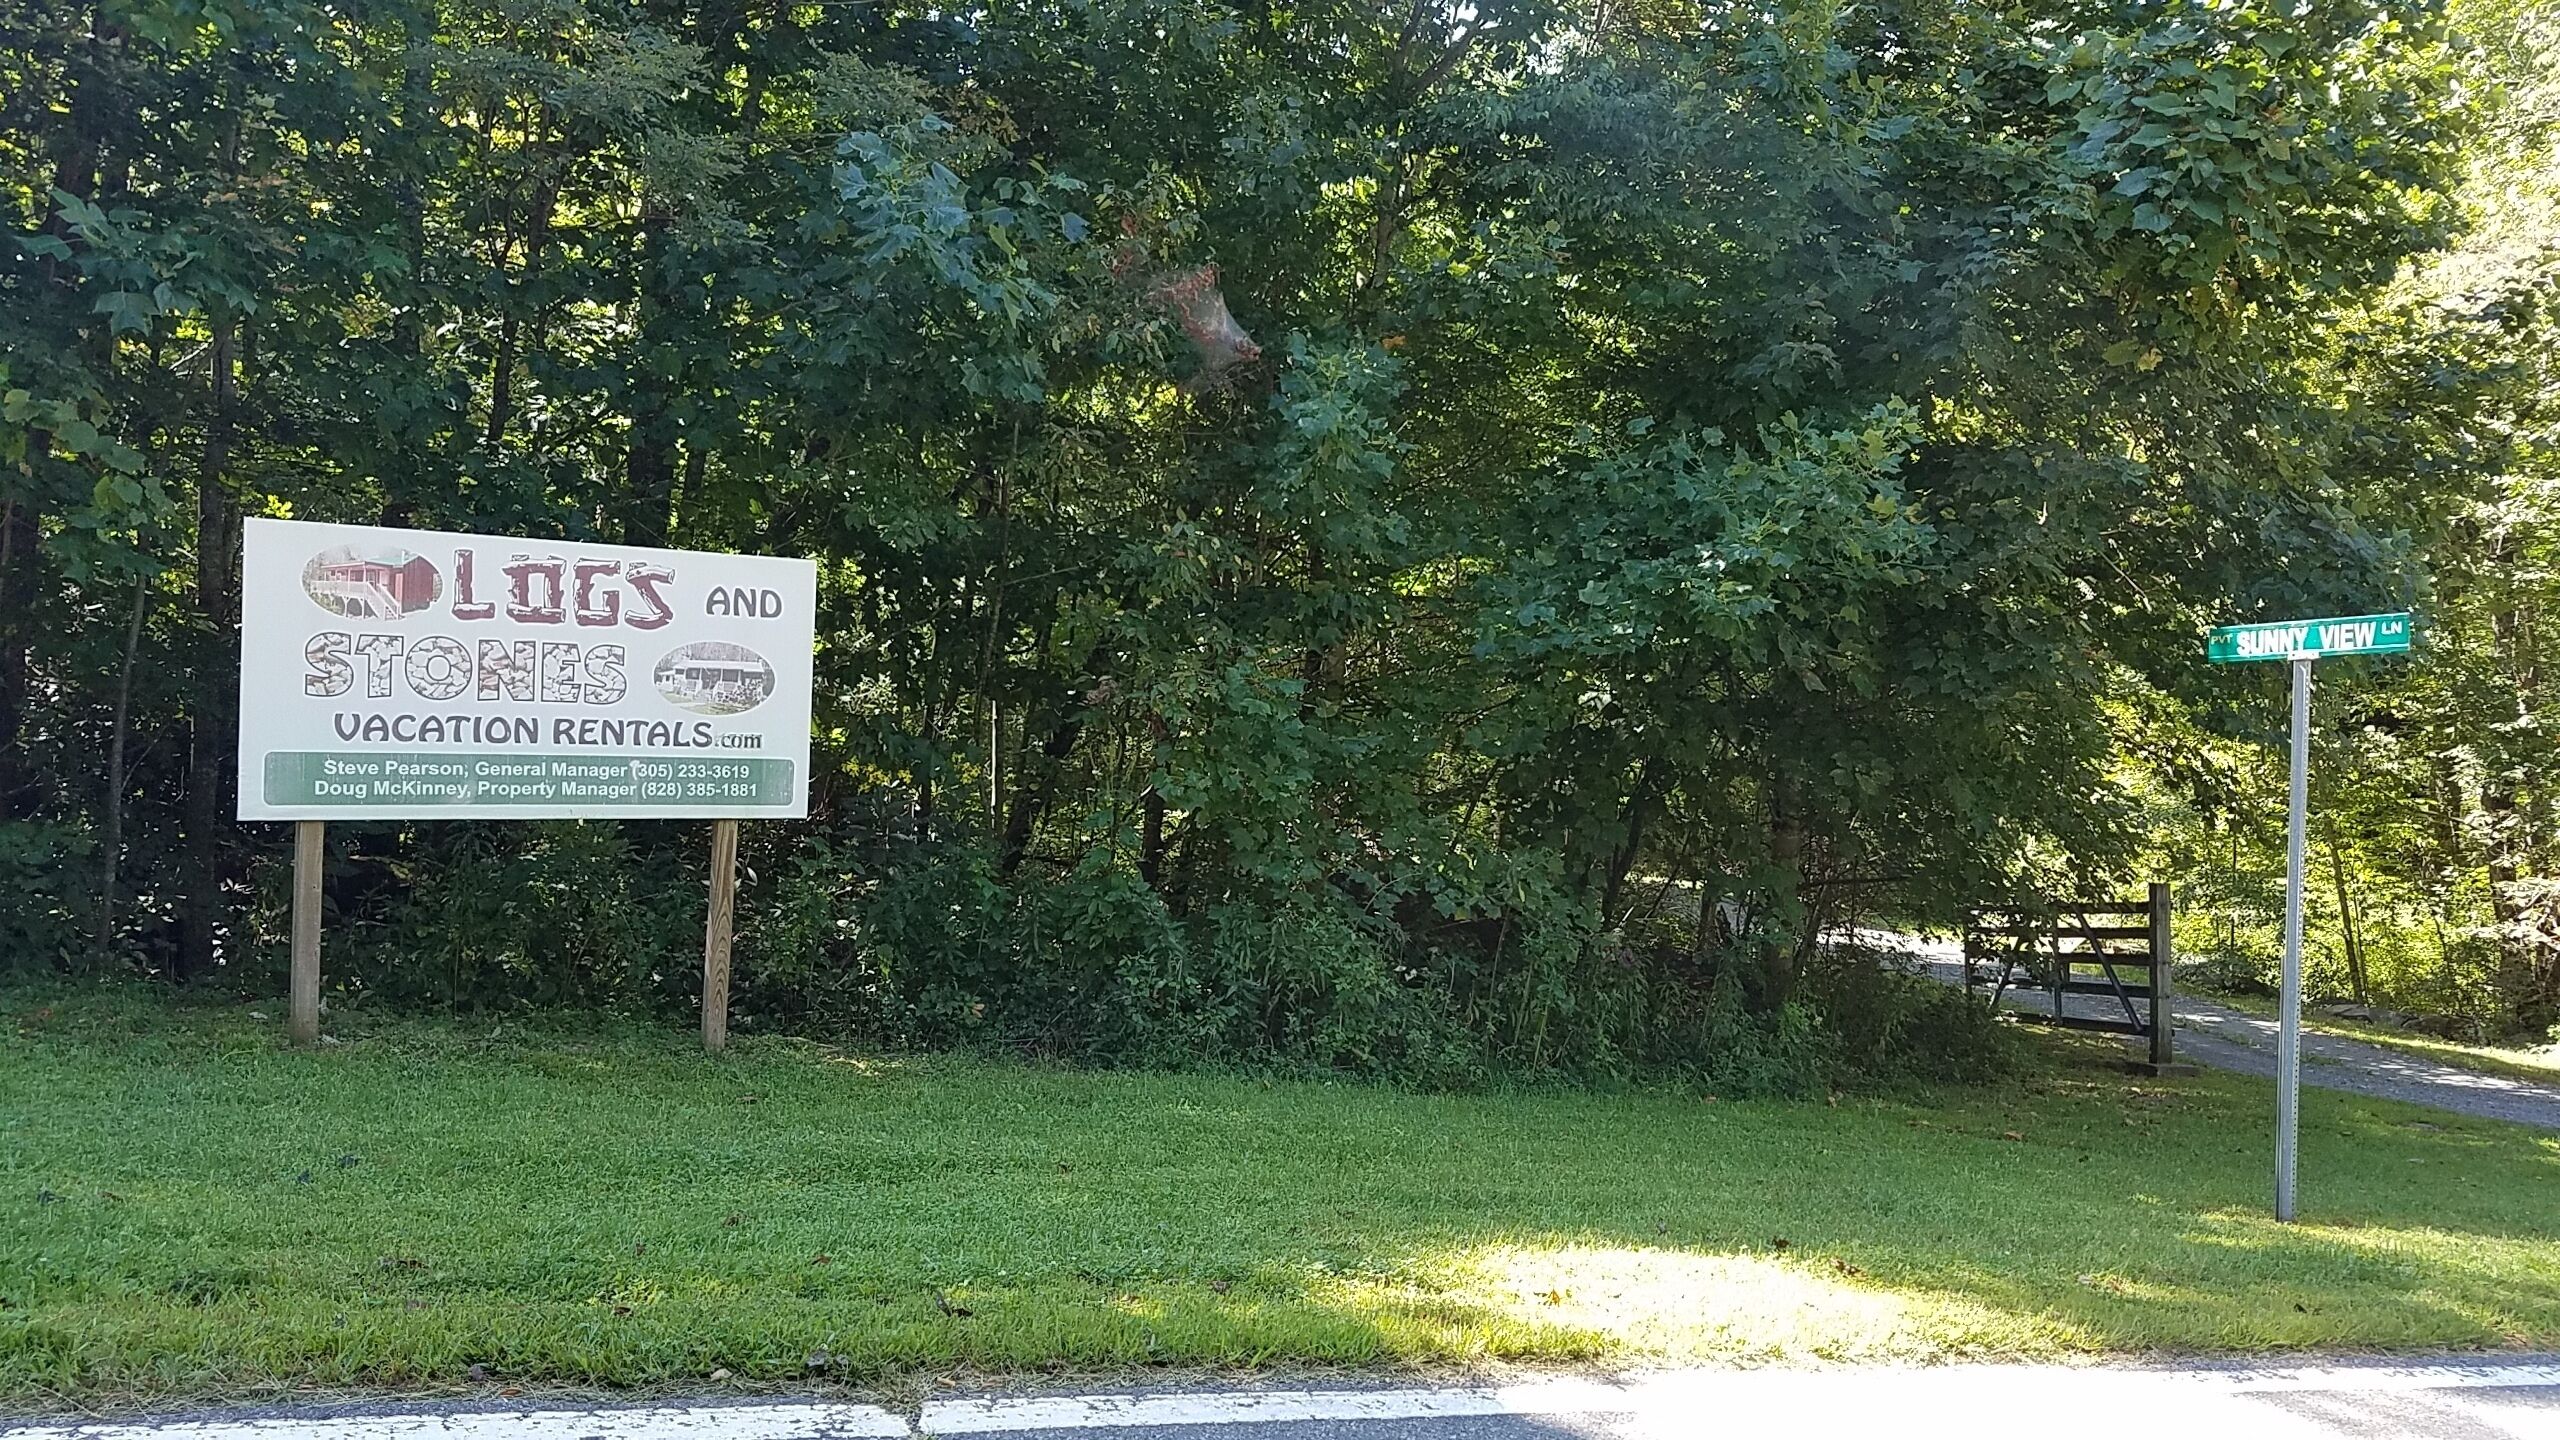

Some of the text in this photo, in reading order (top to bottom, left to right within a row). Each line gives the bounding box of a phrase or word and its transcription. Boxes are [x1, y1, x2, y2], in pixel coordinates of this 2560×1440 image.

[452, 549, 783, 630] LOGS AND
[2211, 621, 2402, 655] PVT SUNNY VIEW LN
[303, 633, 627, 704] STONES
[334, 713, 539, 746] VACATION
[324, 760, 750, 780] Steve Pearson, General Manager (305) 233-3619
[314, 780, 757, 800] Doug McKinney, Property Manager (828) 385-1881
